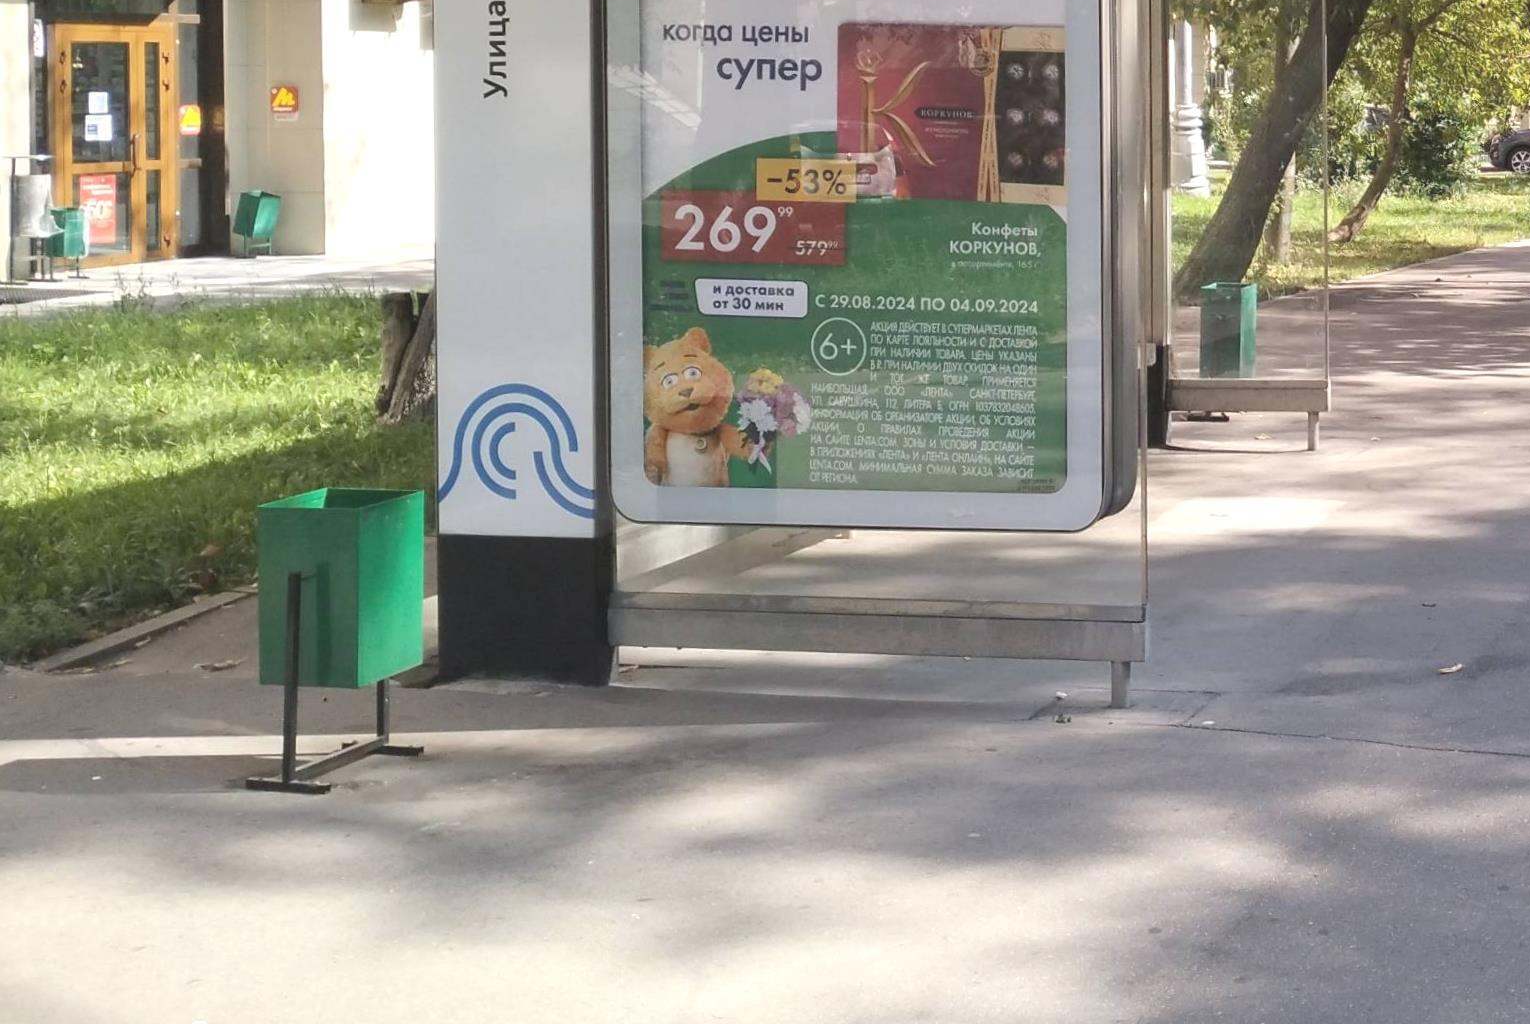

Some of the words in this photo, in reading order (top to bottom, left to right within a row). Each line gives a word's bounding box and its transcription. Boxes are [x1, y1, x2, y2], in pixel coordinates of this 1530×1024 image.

[662, 23, 732, 46] когда
[742, 23, 809, 47] цены
[483, 0, 510, 98] Улица
[716, 56, 822, 91] супер
[767, 168, 846, 195] -53%
[674, 204, 777, 253] 269
[972, 222, 1038, 239] Конфеты
[949, 240, 1041, 257] КОРКУНОВ,
[713, 285, 722, 294] и
[725, 285, 795, 297] доставка
[713, 300, 728, 310] от
[733, 298, 751, 310] 30
[755, 301, 784, 311] мин
[815, 294, 826, 308] С
[830, 294, 916, 311] 29.08.2024
[920, 297, 945, 311] ПО
[950, 298, 1038, 313] 04.09.2024
[819, 332, 857, 360] 6+
[871, 334, 883, 344] ПО
[870, 347, 886, 357] ПРИ
[971, 349, 993, 361] ЦЕНЫ
